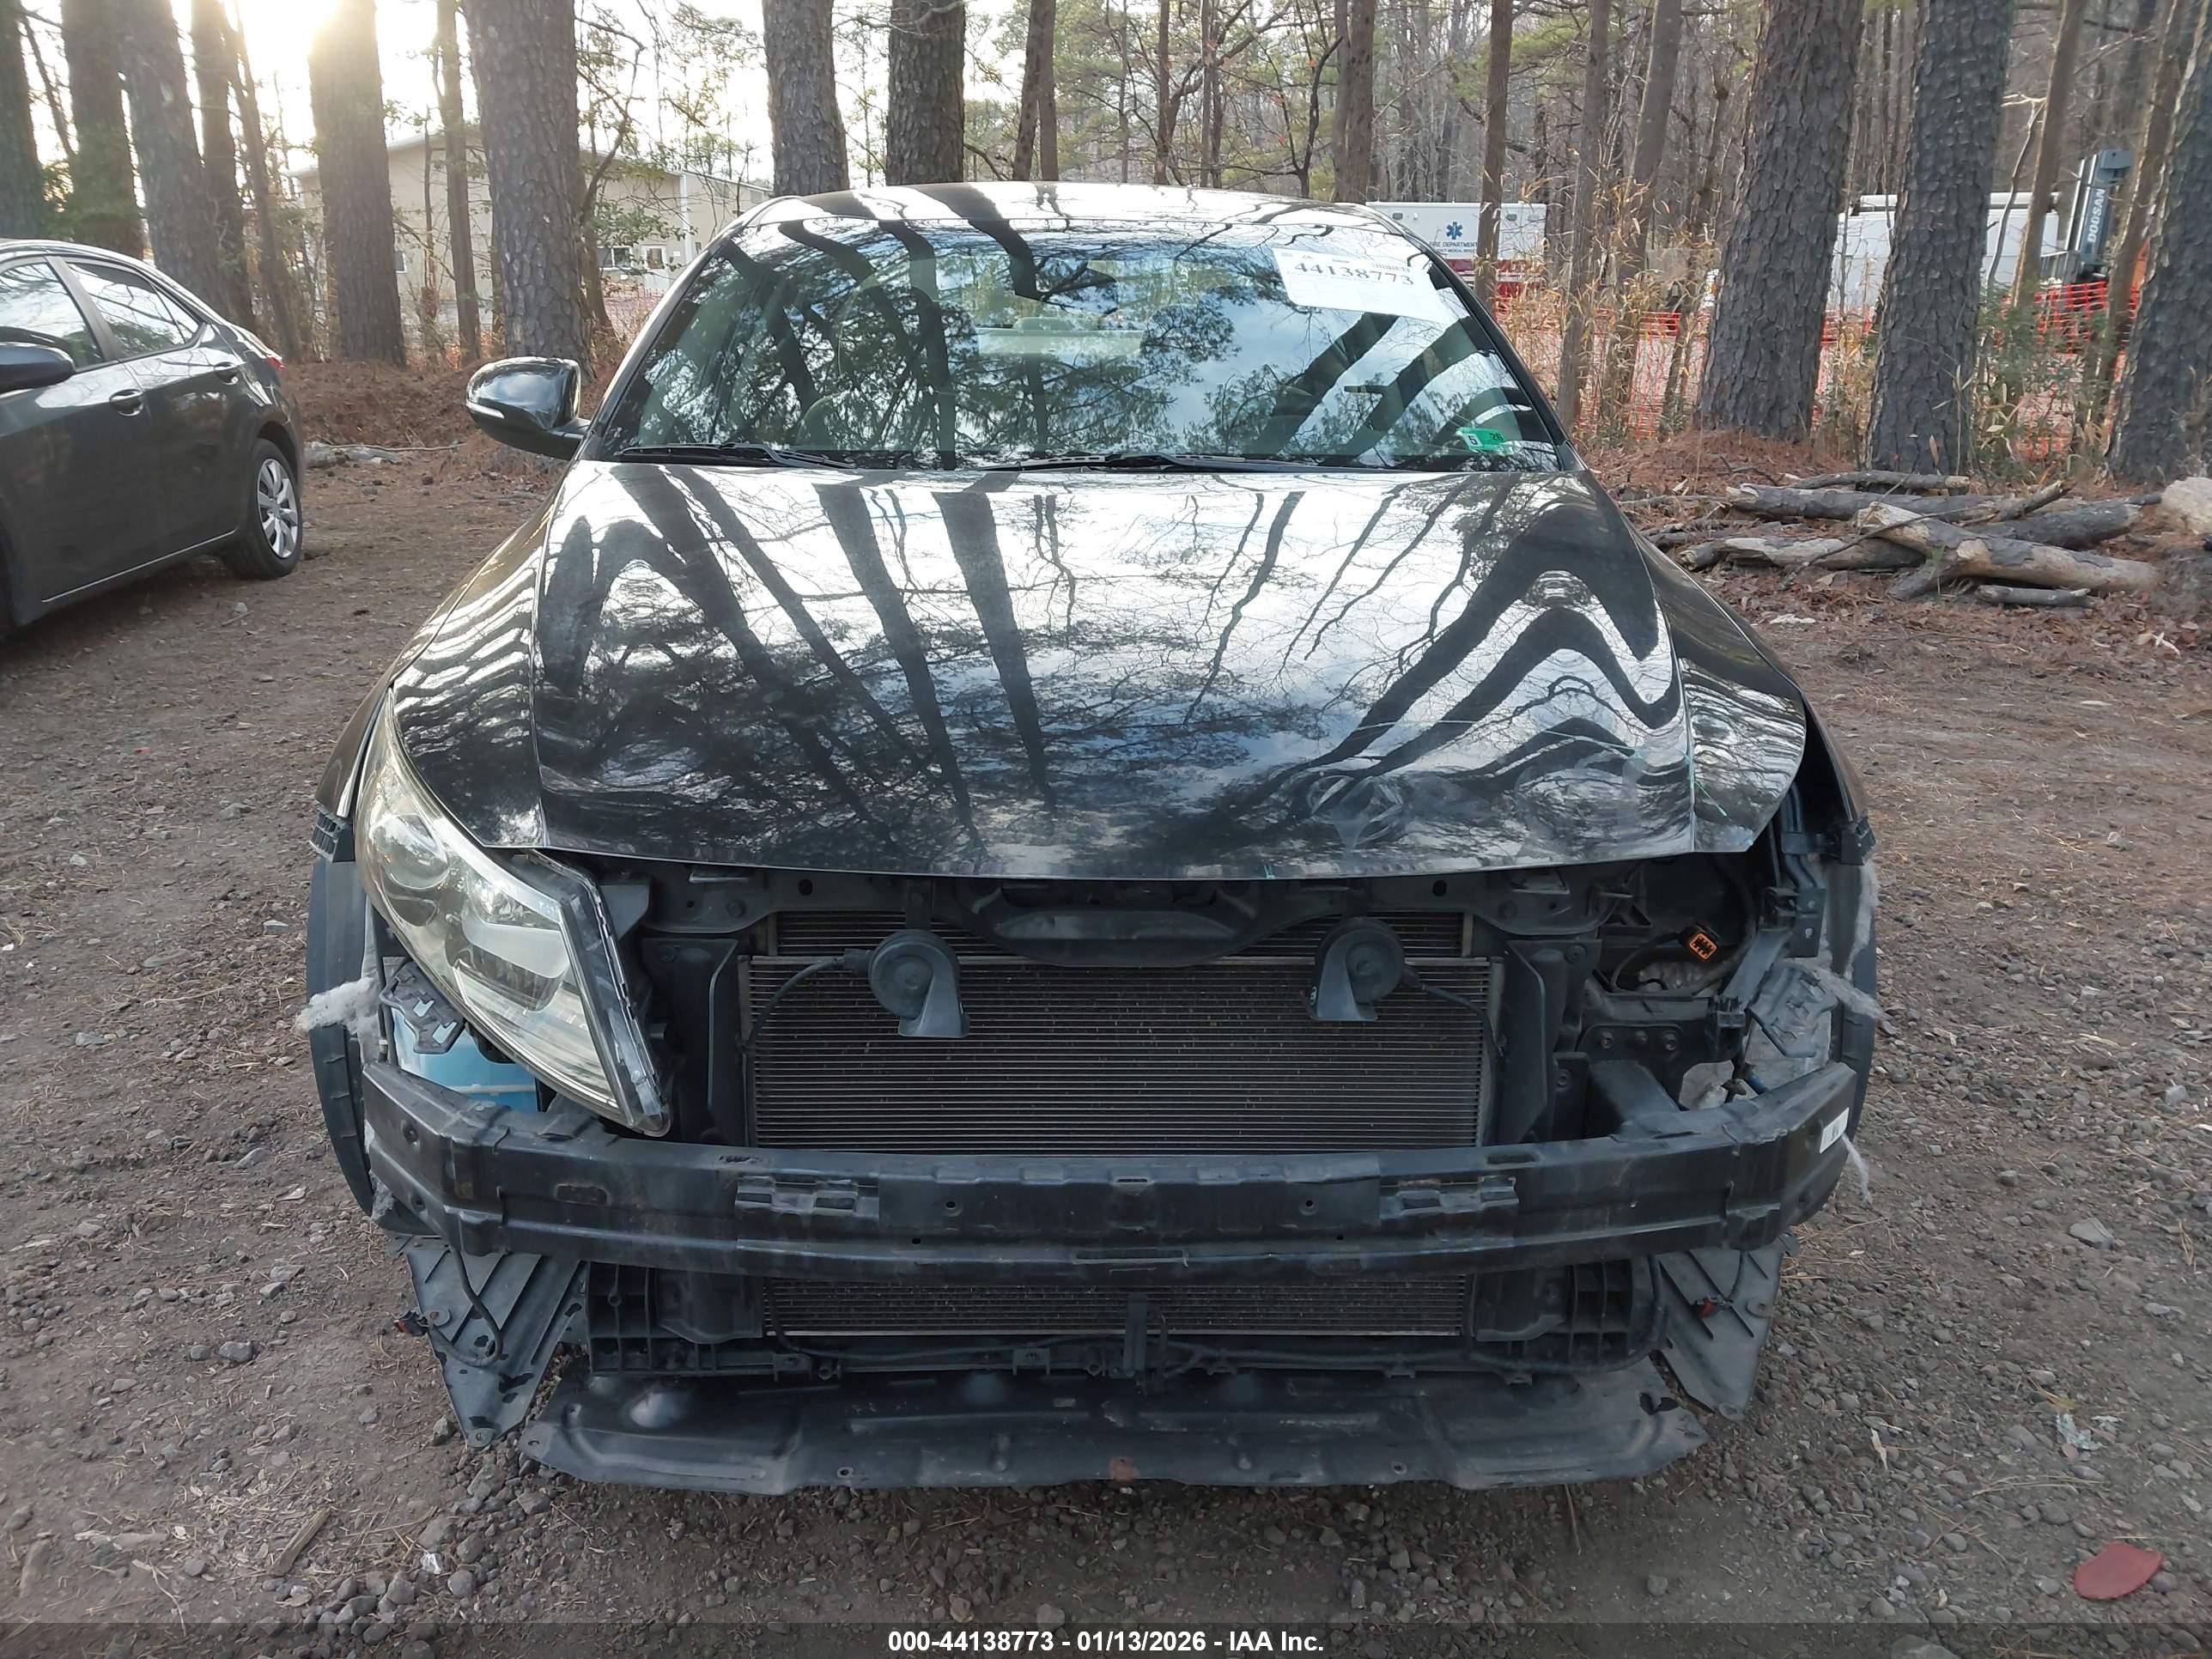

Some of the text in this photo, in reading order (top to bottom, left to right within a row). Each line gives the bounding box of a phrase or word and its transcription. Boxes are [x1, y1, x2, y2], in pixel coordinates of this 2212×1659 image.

[2087, 188, 2106, 243] DOOSAN
[1294, 263, 1414, 285] 44138773
[1468, 435, 1479, 446] 5
